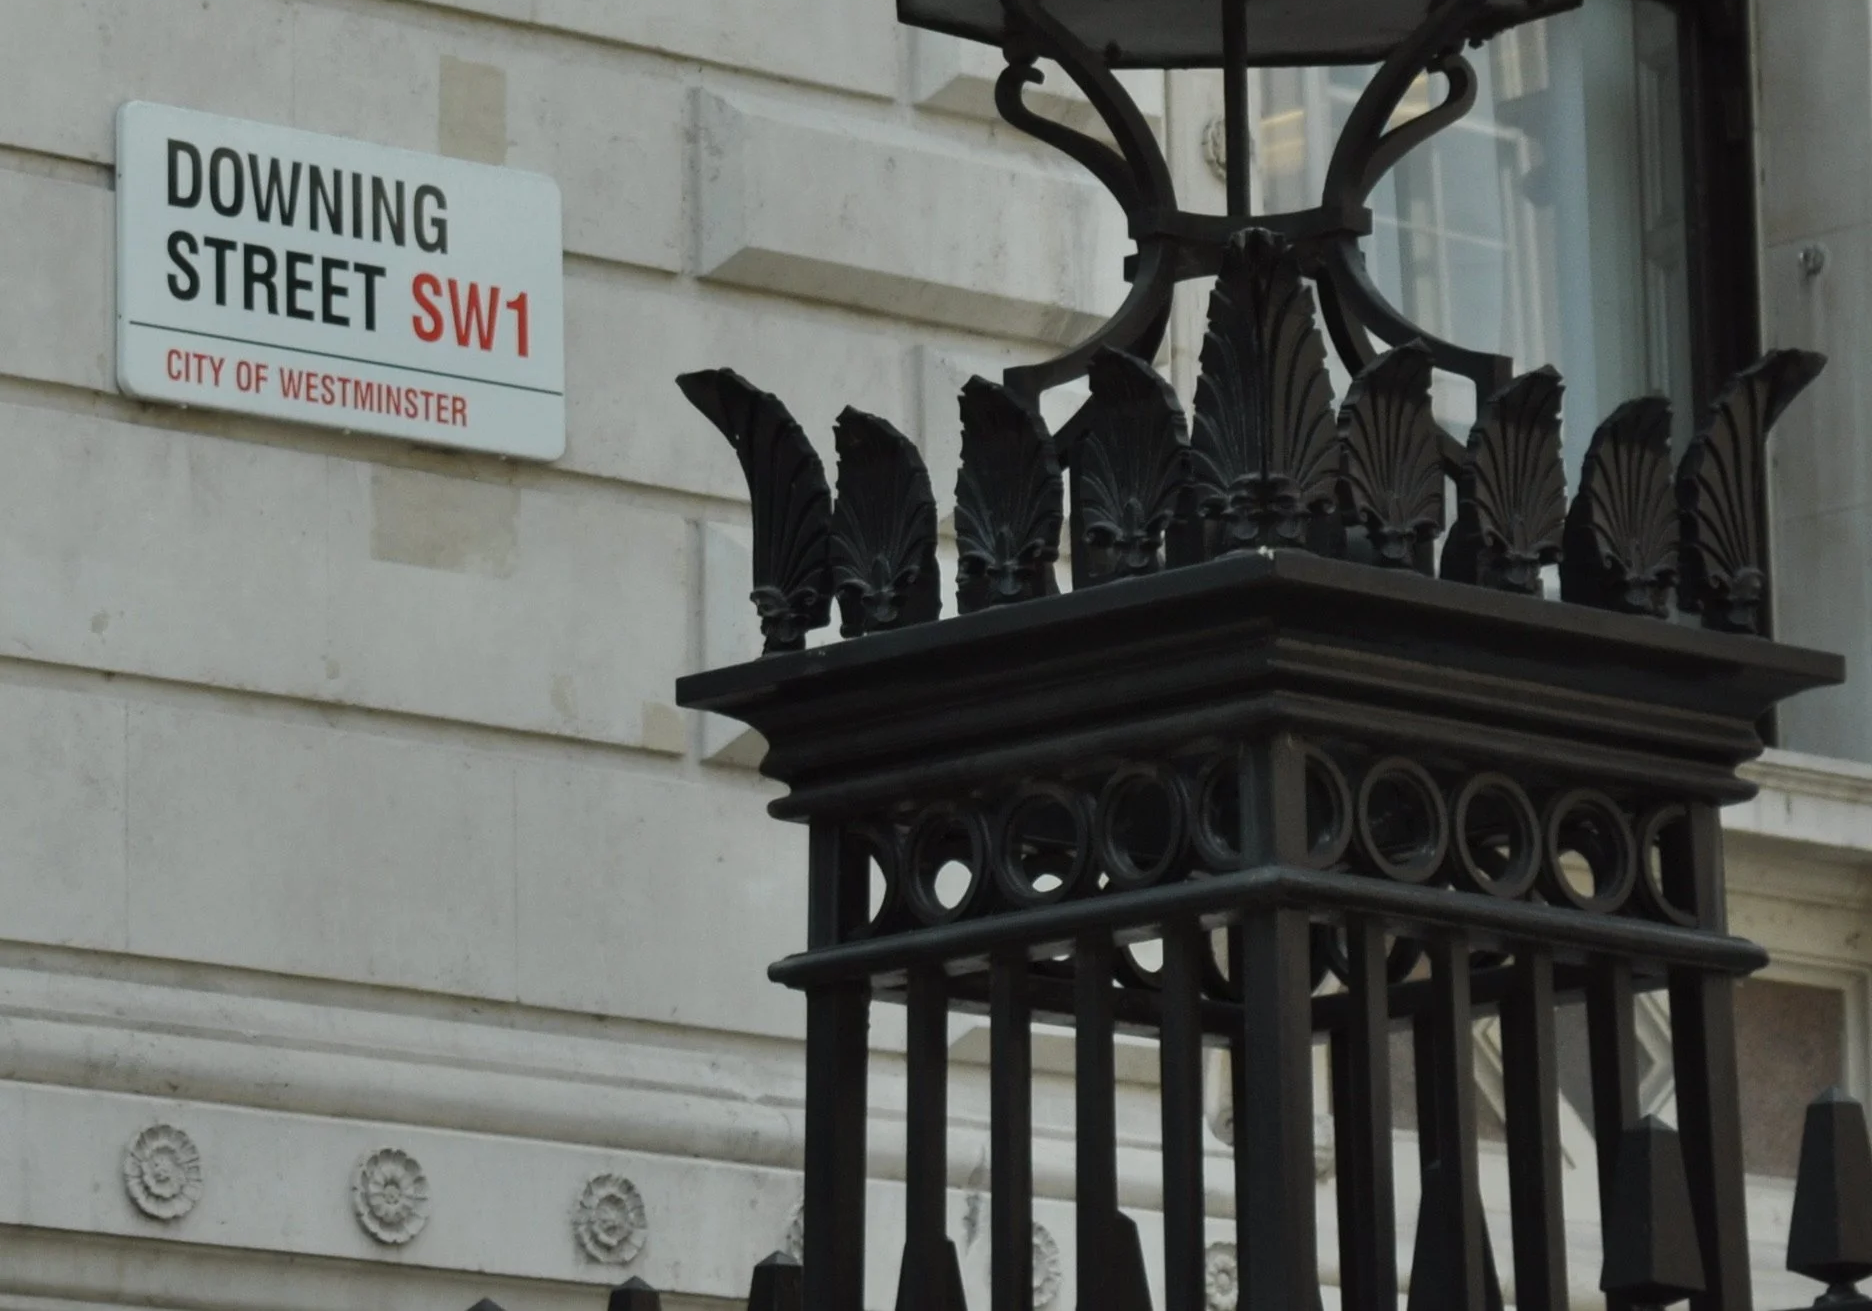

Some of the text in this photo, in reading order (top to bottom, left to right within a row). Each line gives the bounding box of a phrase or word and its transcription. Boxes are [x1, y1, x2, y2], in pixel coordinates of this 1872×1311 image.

[167, 138, 448, 255] DOWNING
[167, 230, 529, 358] STREET SW1
[166, 349, 468, 427] CITY OF WESTMINSTER
